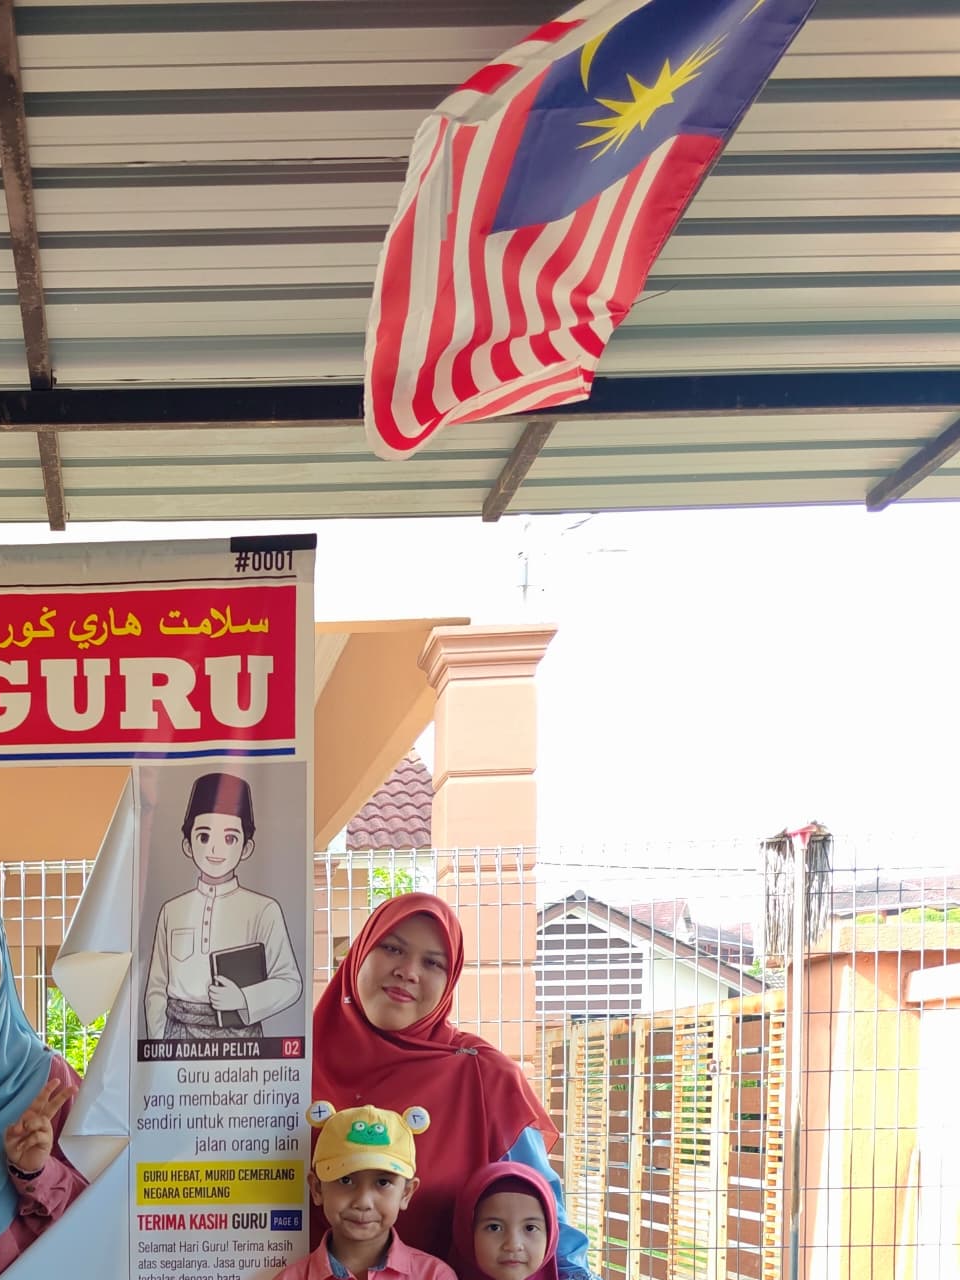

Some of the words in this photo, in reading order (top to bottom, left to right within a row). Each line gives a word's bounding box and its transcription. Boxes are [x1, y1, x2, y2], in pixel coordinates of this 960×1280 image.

[235, 550, 293, 572] #0001
[69, 607, 142, 650] هاري
[159, 604, 269, 638] سلامت
[143, 1044, 172, 1058] GURU
[175, 1043, 219, 1057] ADALAH
[223, 1042, 260, 1056] PELITA
[284, 1041, 300, 1055] 02
[177, 1067, 210, 1083] Guru
[214, 1067, 258, 1083] adalah
[263, 1066, 300, 1085] pelita
[143, 1094, 175, 1110] yang
[179, 1090, 249, 1106] membakar
[253, 1089, 300, 1108] dirinya
[137, 1113, 182, 1130] sendiri
[187, 1113, 224, 1129] untuk
[228, 1112, 299, 1131] menerangi
[195, 1136, 227, 1156] jalan
[231, 1139, 270, 1154] orang
[275, 1136, 299, 1151] lain
[143, 1170, 168, 1182] GURU
[171, 1170, 202, 1183] HEBAT,
[205, 1169, 236, 1181] MURID
[238, 1168, 295, 1181] CEMERLANG
[143, 1187, 180, 1199] NEGARA
[182, 1186, 230, 1199] GEMILANG
[137, 1214, 186, 1231] TERIMA
[189, 1213, 228, 1230] KASIH
[232, 1212, 268, 1230] GURU
[273, 1217, 292, 1226] PAGE
[138, 1241, 176, 1253] Selamat
[179, 1241, 199, 1253] Hari
[202, 1240, 229, 1252] Guru!
[232, 1240, 264, 1252] Terima
[267, 1240, 293, 1251] kasih
[138, 1258, 158, 1270] atas
[160, 1258, 210, 1271] segalanya.
[213, 1257, 235, 1269] Jasa
[238, 1259, 260, 1271] guru
[263, 1256, 287, 1268] tidak
